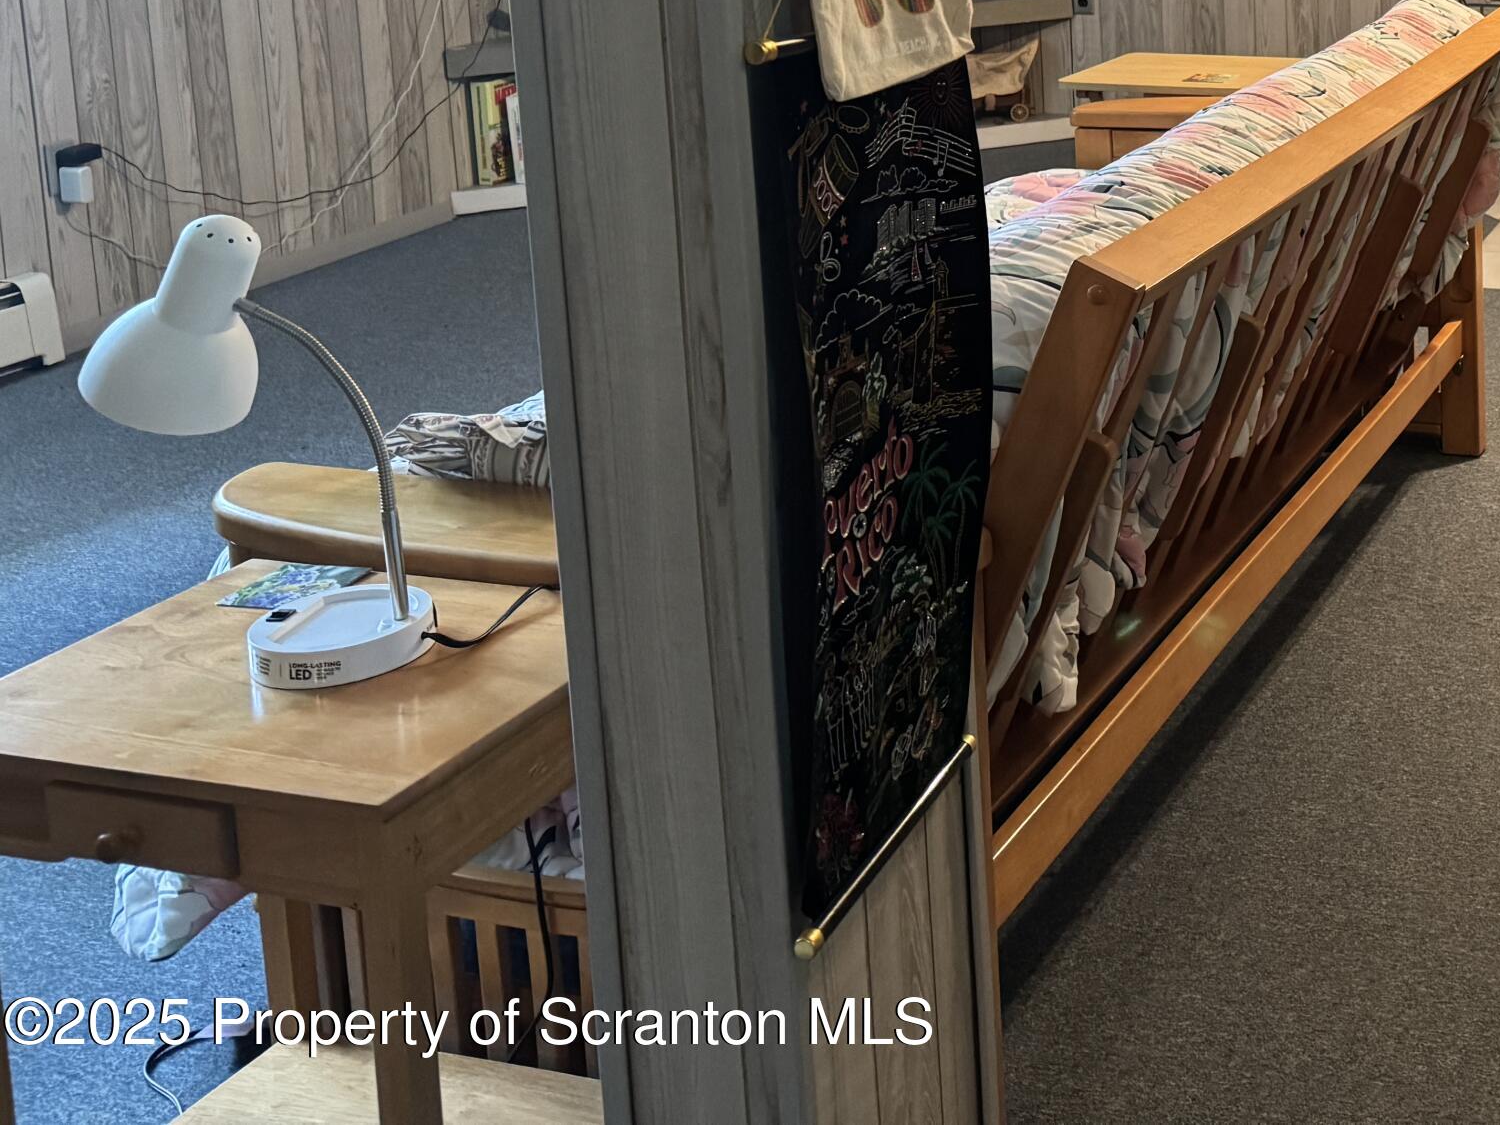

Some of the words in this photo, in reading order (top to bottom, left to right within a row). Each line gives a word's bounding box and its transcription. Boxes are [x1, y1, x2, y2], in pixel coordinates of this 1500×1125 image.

[821, 415, 914, 573] Puerto
[832, 495, 899, 616] Rico
[289, 660, 342, 669] LONG-LASTING
[289, 669, 312, 680] LED
